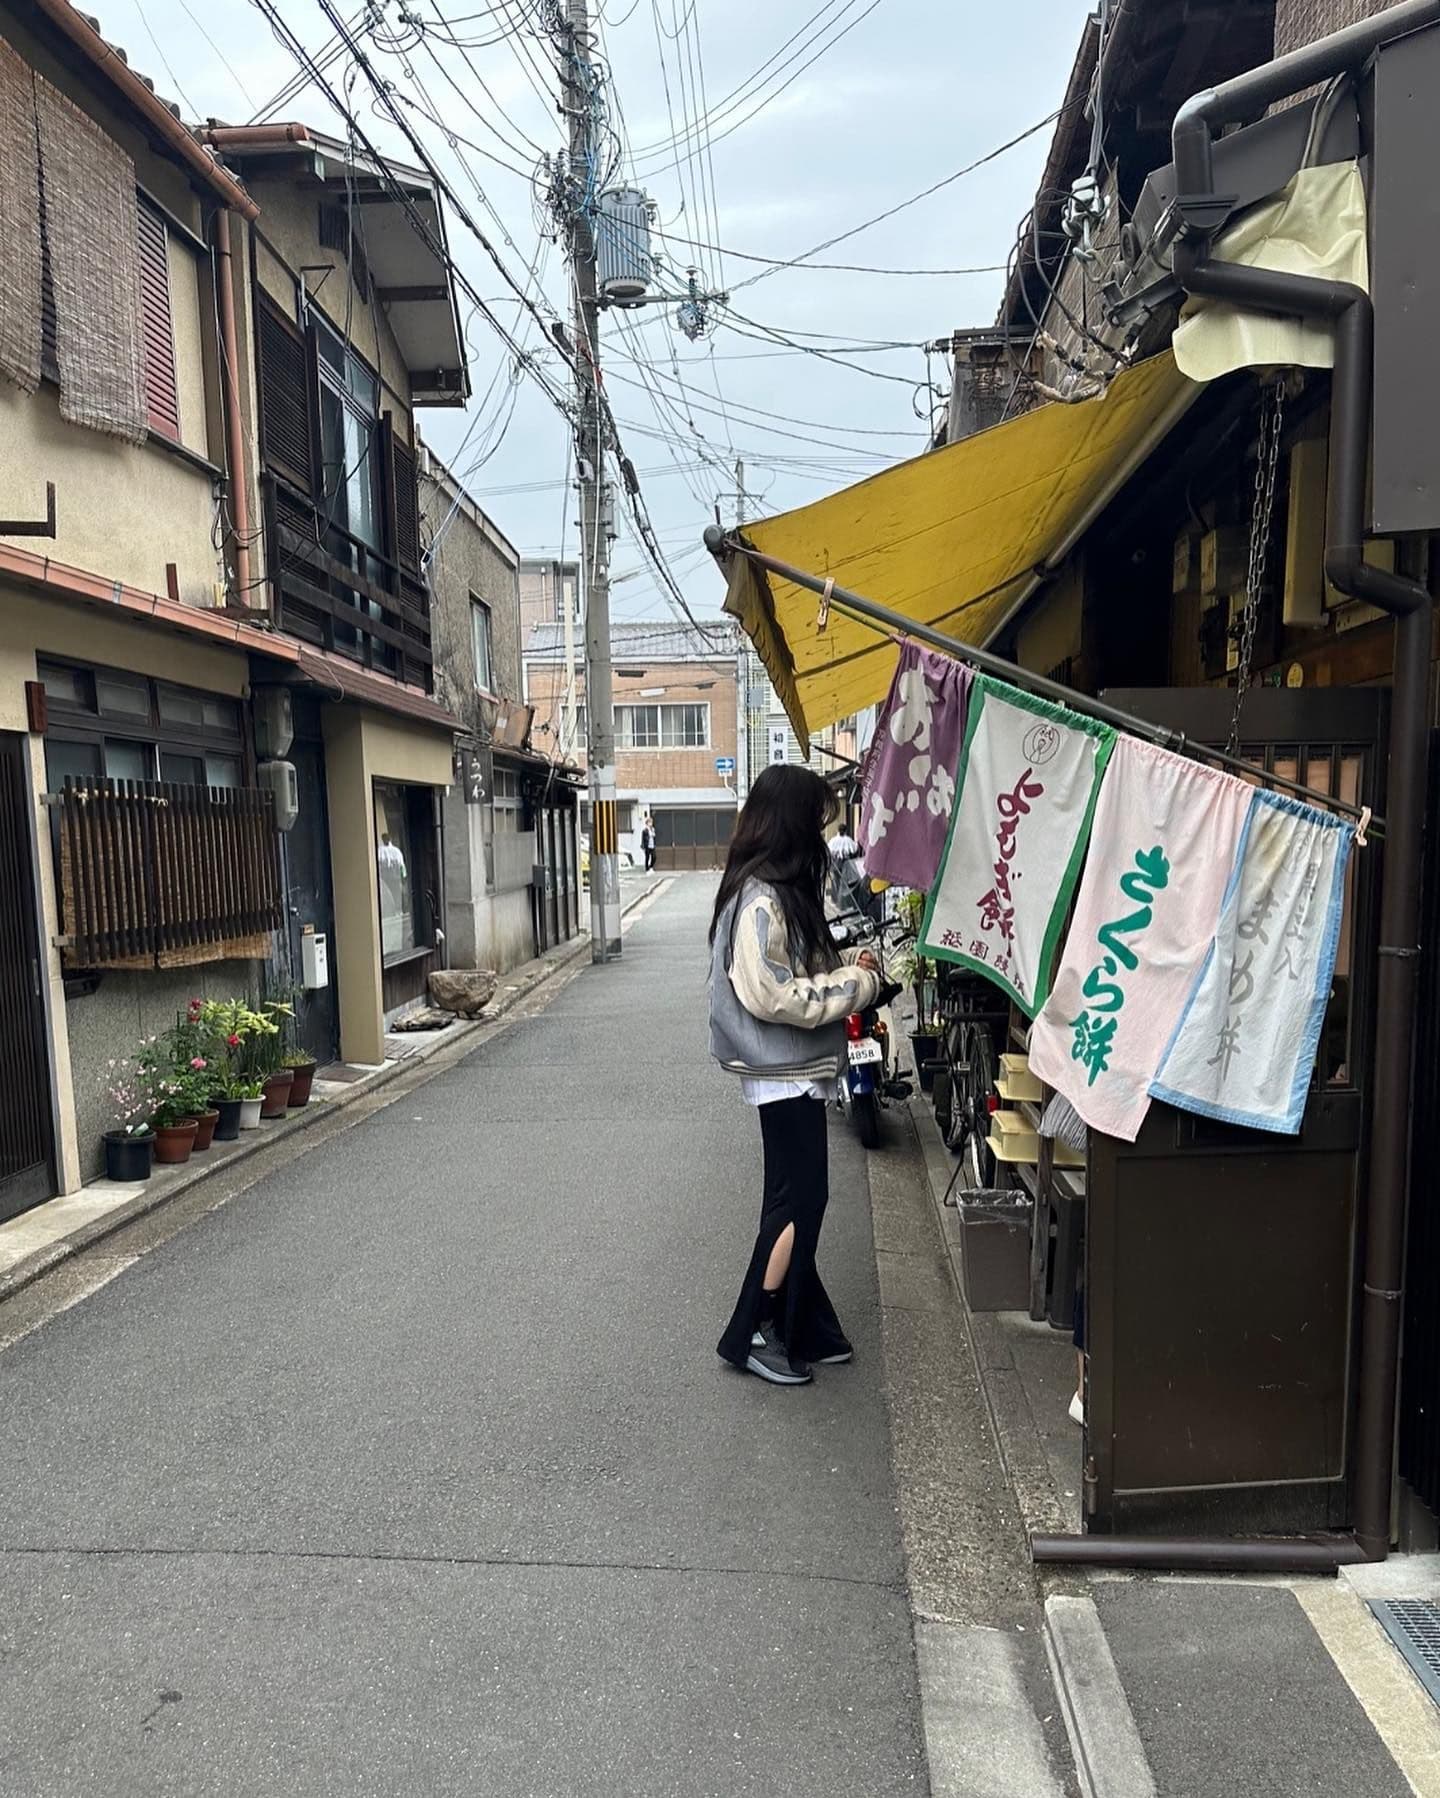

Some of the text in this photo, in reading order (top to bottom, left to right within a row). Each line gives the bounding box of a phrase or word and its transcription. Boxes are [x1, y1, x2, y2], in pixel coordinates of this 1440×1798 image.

[470, 757, 486, 799] うつわ
[977, 767, 1044, 957] よもぎ餅
[1068, 845, 1171, 1087] さくら餅
